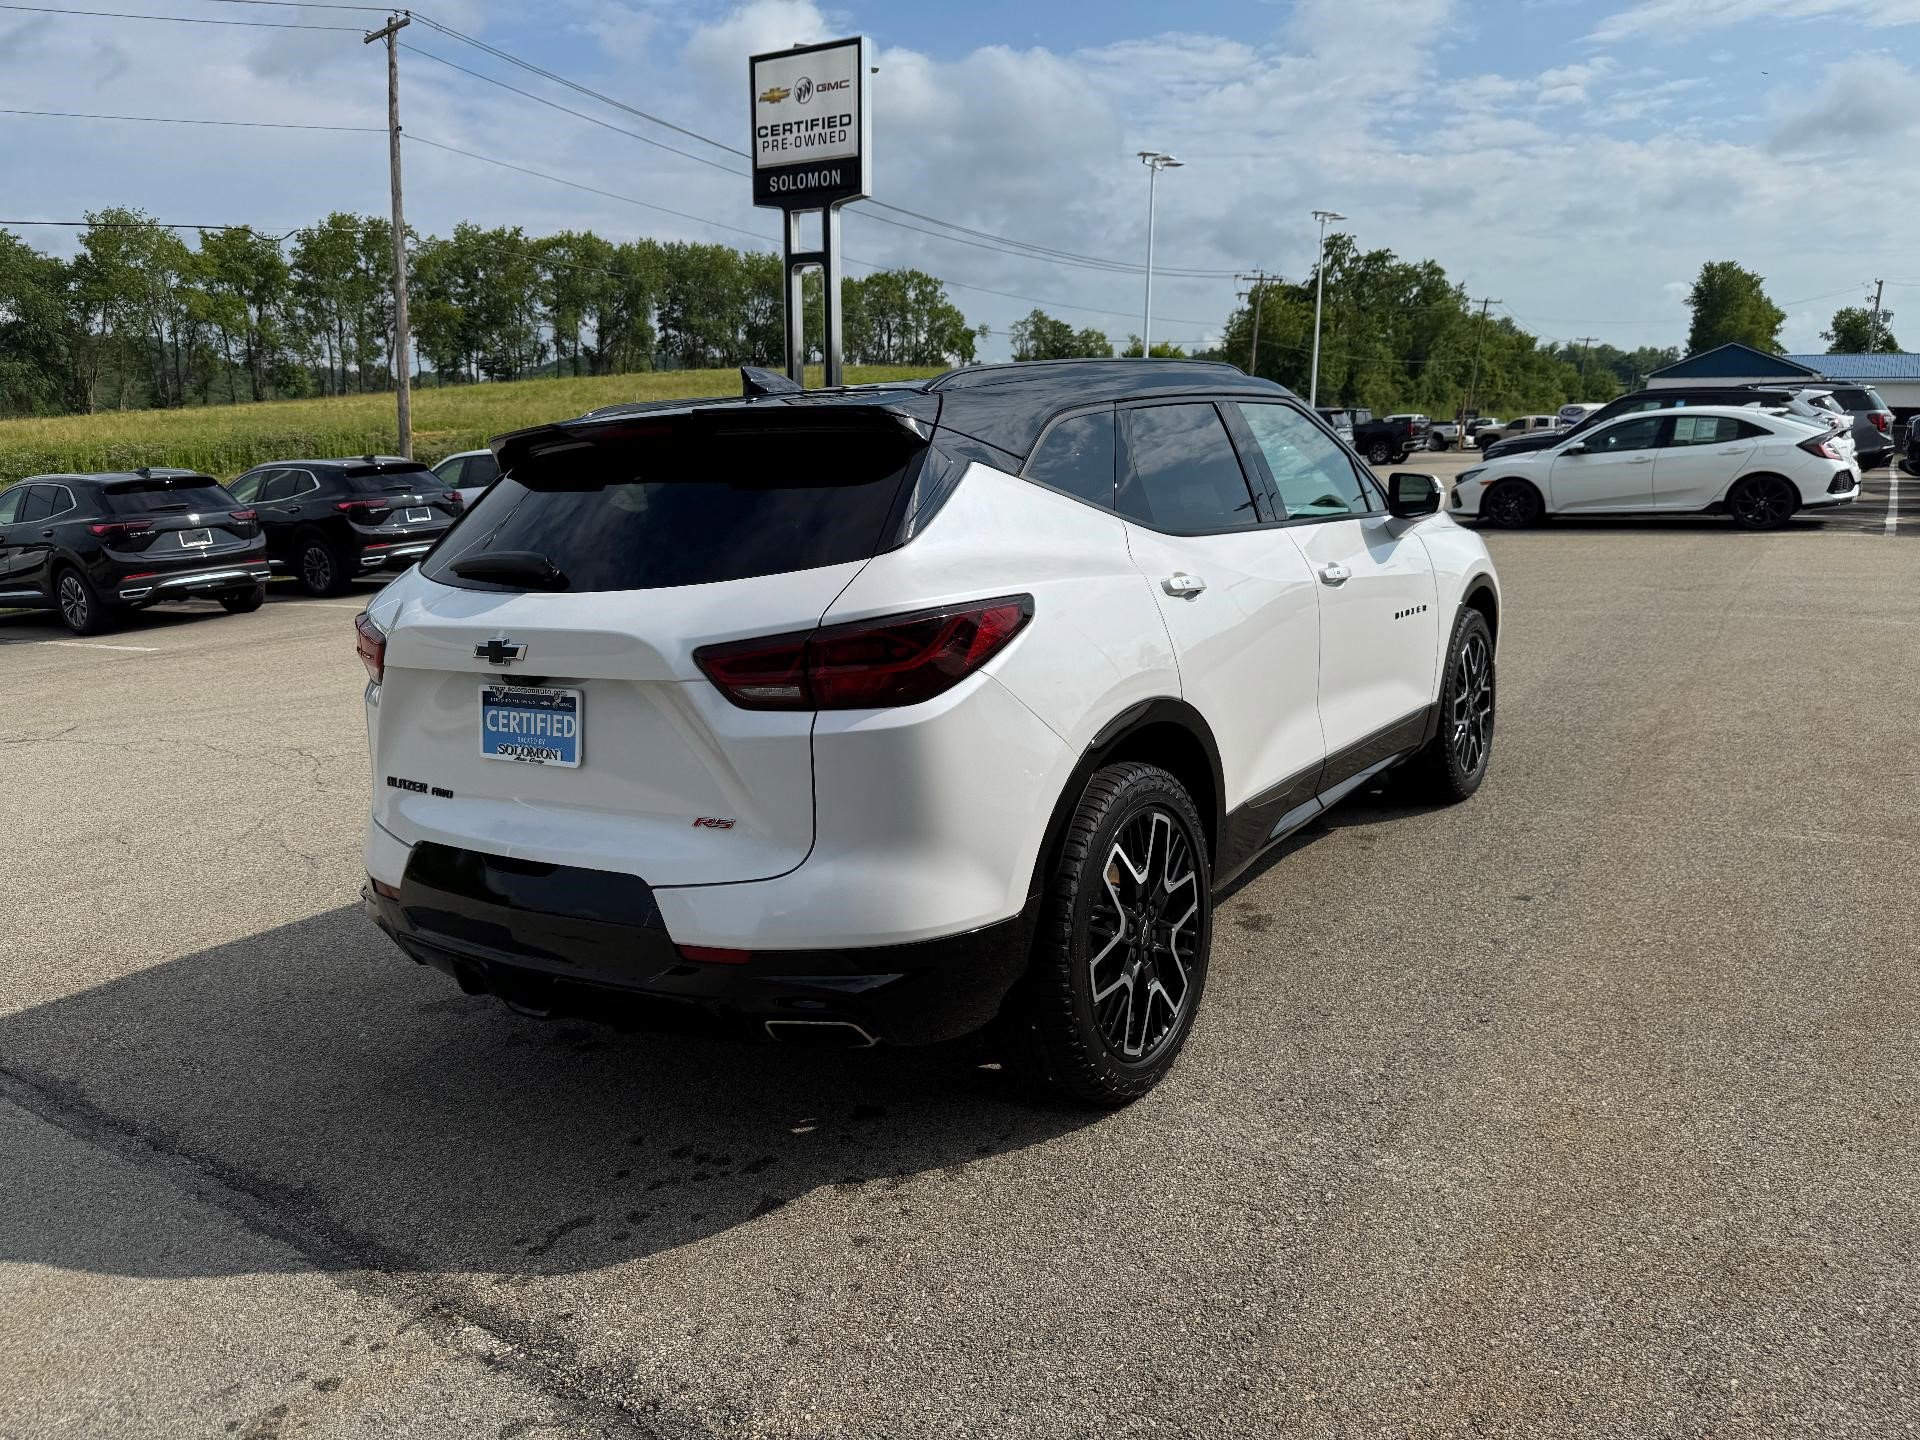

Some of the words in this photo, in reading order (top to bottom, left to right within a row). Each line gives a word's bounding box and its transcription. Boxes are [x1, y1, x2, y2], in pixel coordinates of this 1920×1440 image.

[816, 79, 850, 93] GMC
[757, 113, 852, 139] CERTIFIED
[762, 129, 847, 152] PRE-OWNED
[769, 168, 841, 192] SOLOMON
[488, 685, 568, 697] www.solomonauto.com
[486, 709, 576, 738] CERTIFIED
[498, 744, 559, 760] SOLOMON
[386, 775, 428, 793] BLAZER
[431, 787, 454, 799] AWD
[692, 816, 736, 830] RS
